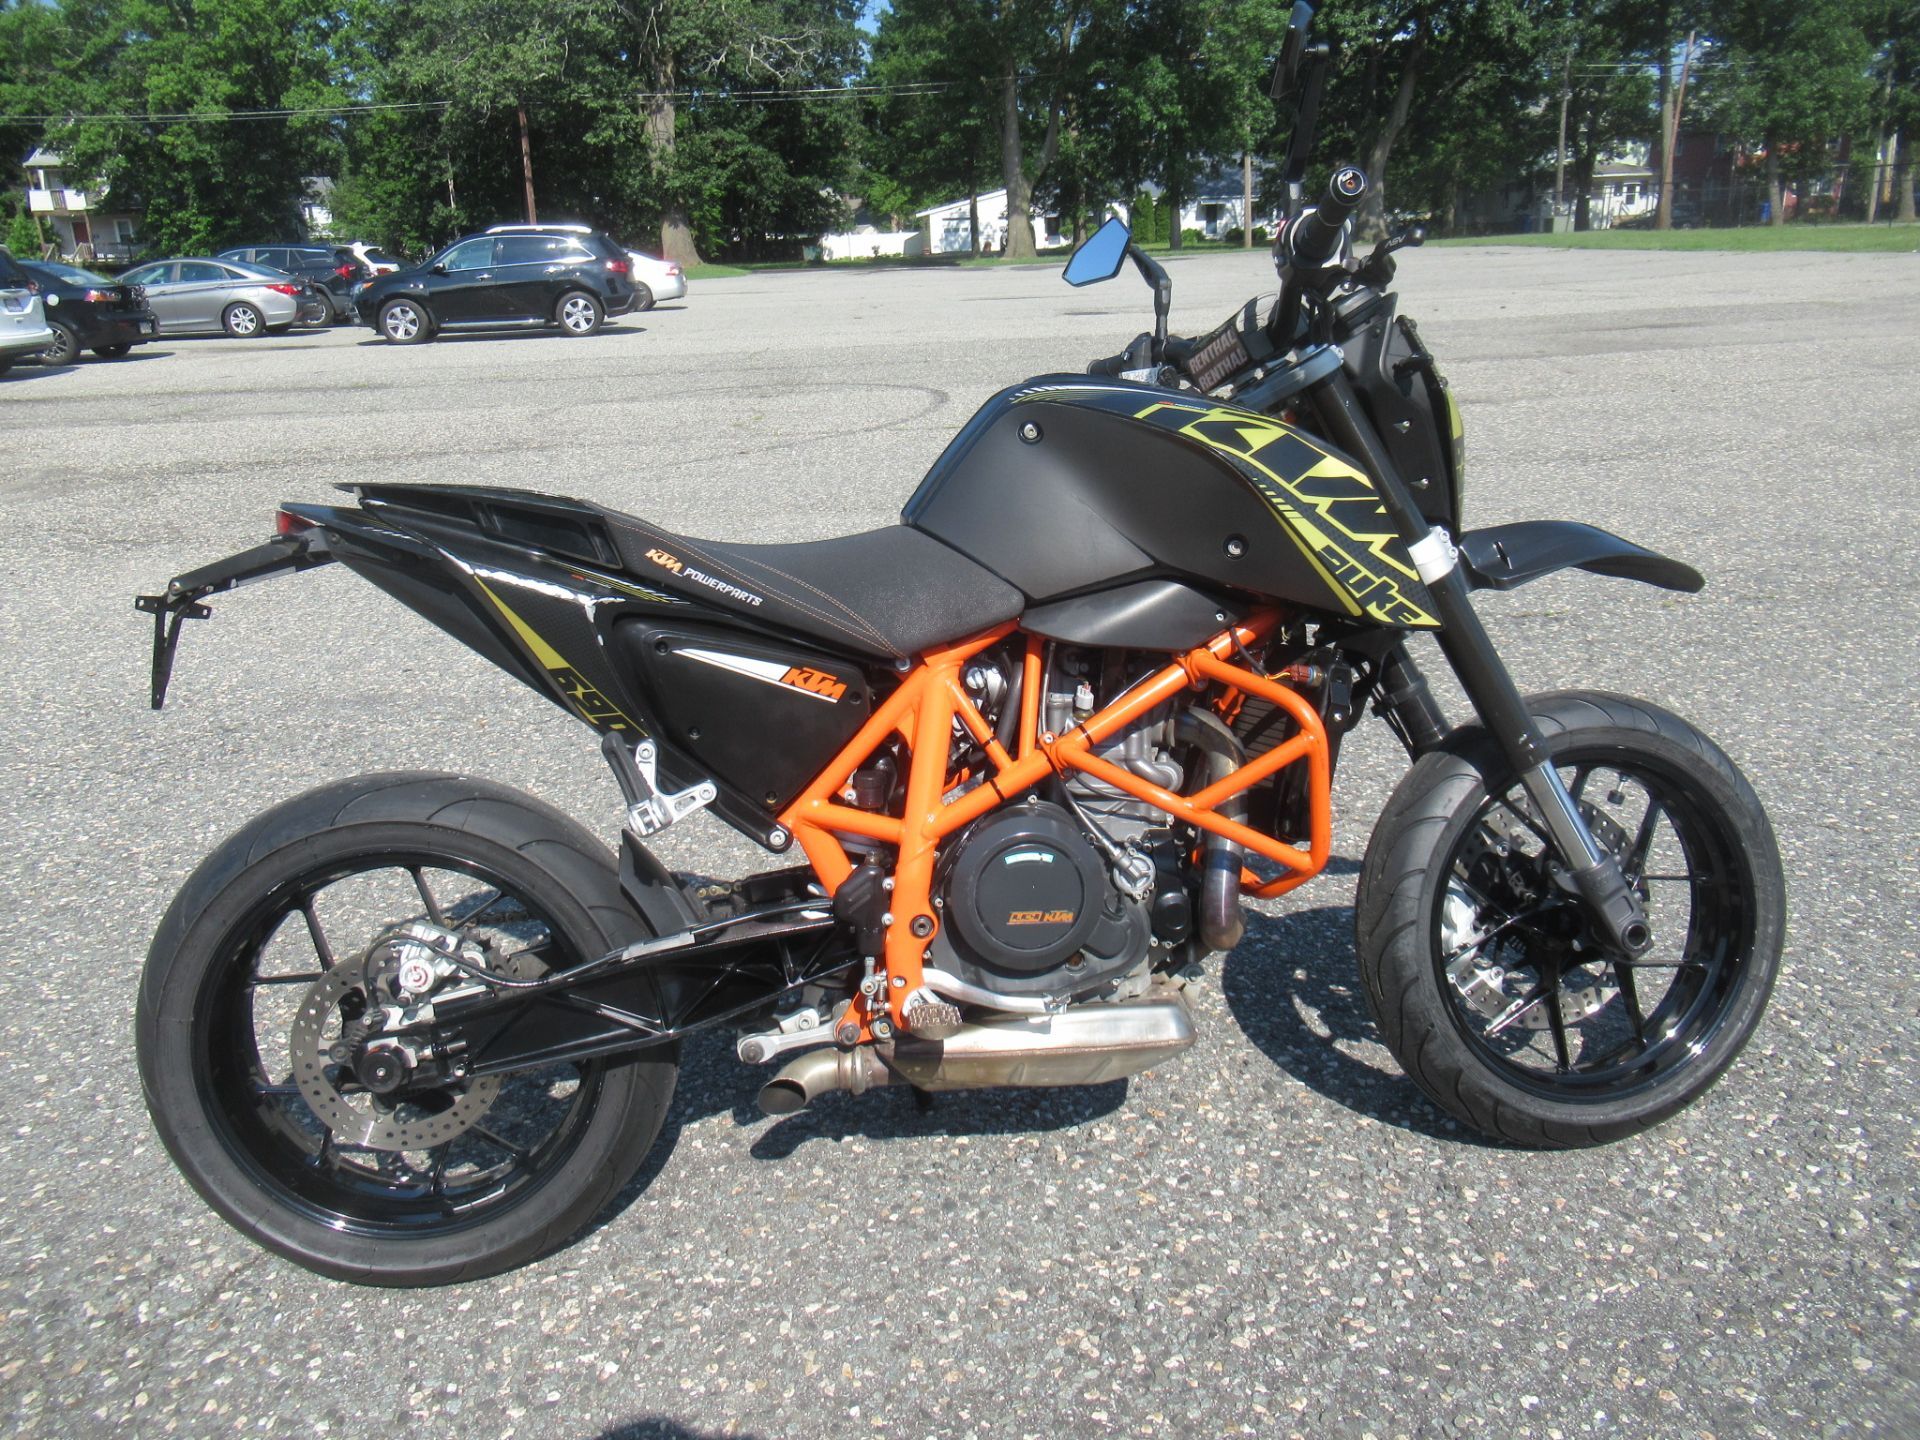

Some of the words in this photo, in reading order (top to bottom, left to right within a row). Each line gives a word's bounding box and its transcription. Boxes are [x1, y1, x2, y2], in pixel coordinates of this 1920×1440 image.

[1188, 328, 1239, 375] RENTHAL
[1197, 347, 1249, 391] RENTHAL
[644, 547, 684, 575] KTM
[683, 566, 764, 607] POWERPARTS
[780, 666, 848, 702] KTM
[1043, 910, 1074, 924] KTM
